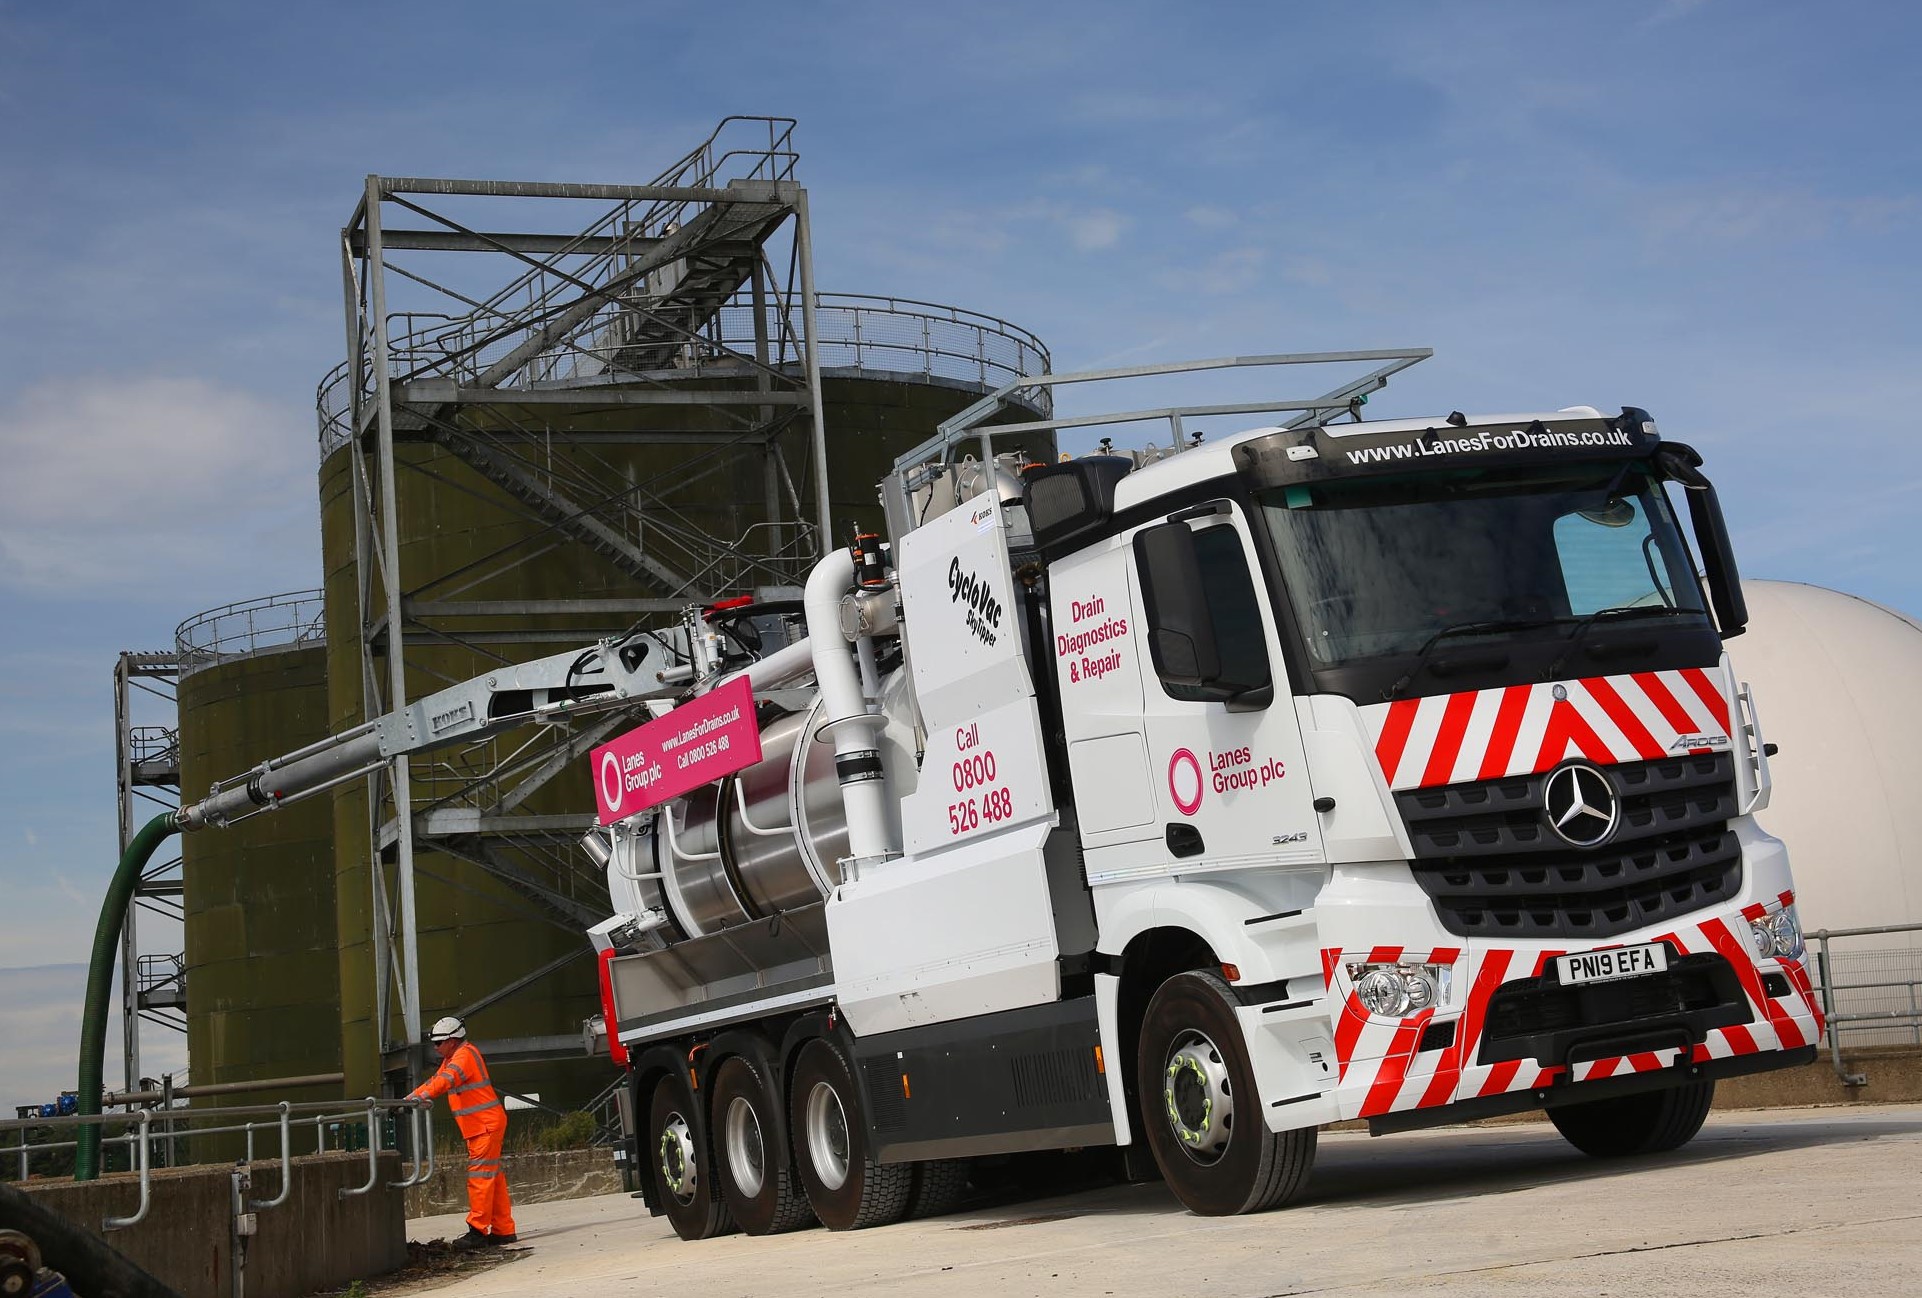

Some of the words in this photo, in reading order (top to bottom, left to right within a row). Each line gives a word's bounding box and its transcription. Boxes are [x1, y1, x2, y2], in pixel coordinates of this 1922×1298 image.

[1346, 428, 1633, 465] www.LanesForDrains.co.uk
[949, 556, 1002, 629] CycloVac
[1071, 594, 1105, 623] Drain
[966, 609, 997, 648] SkyTipper
[1057, 617, 1128, 657] Diagnostics
[1070, 661, 1081, 684] &
[1081, 648, 1121, 680] Repair
[661, 705, 741, 753] www.LanesForDrains.co.uk
[956, 722, 980, 752] Call
[621, 751, 645, 774] Lanes
[677, 752, 690, 770] Call
[688, 747, 706, 766] 0800
[705, 741, 718, 757] 526
[717, 735, 730, 752] 488
[1208, 747, 1252, 772] Lanes
[624, 768, 649, 793] Group
[649, 761, 662, 786] plc
[953, 750, 996, 793] 0800
[1212, 768, 1258, 794] Group
[1260, 757, 1286, 787] plc
[948, 798, 979, 835] 526
[982, 787, 1013, 823] 488
[1272, 832, 1308, 846] 3243
[1569, 954, 1613, 980] PN19
[1617, 948, 1655, 974] EFA
